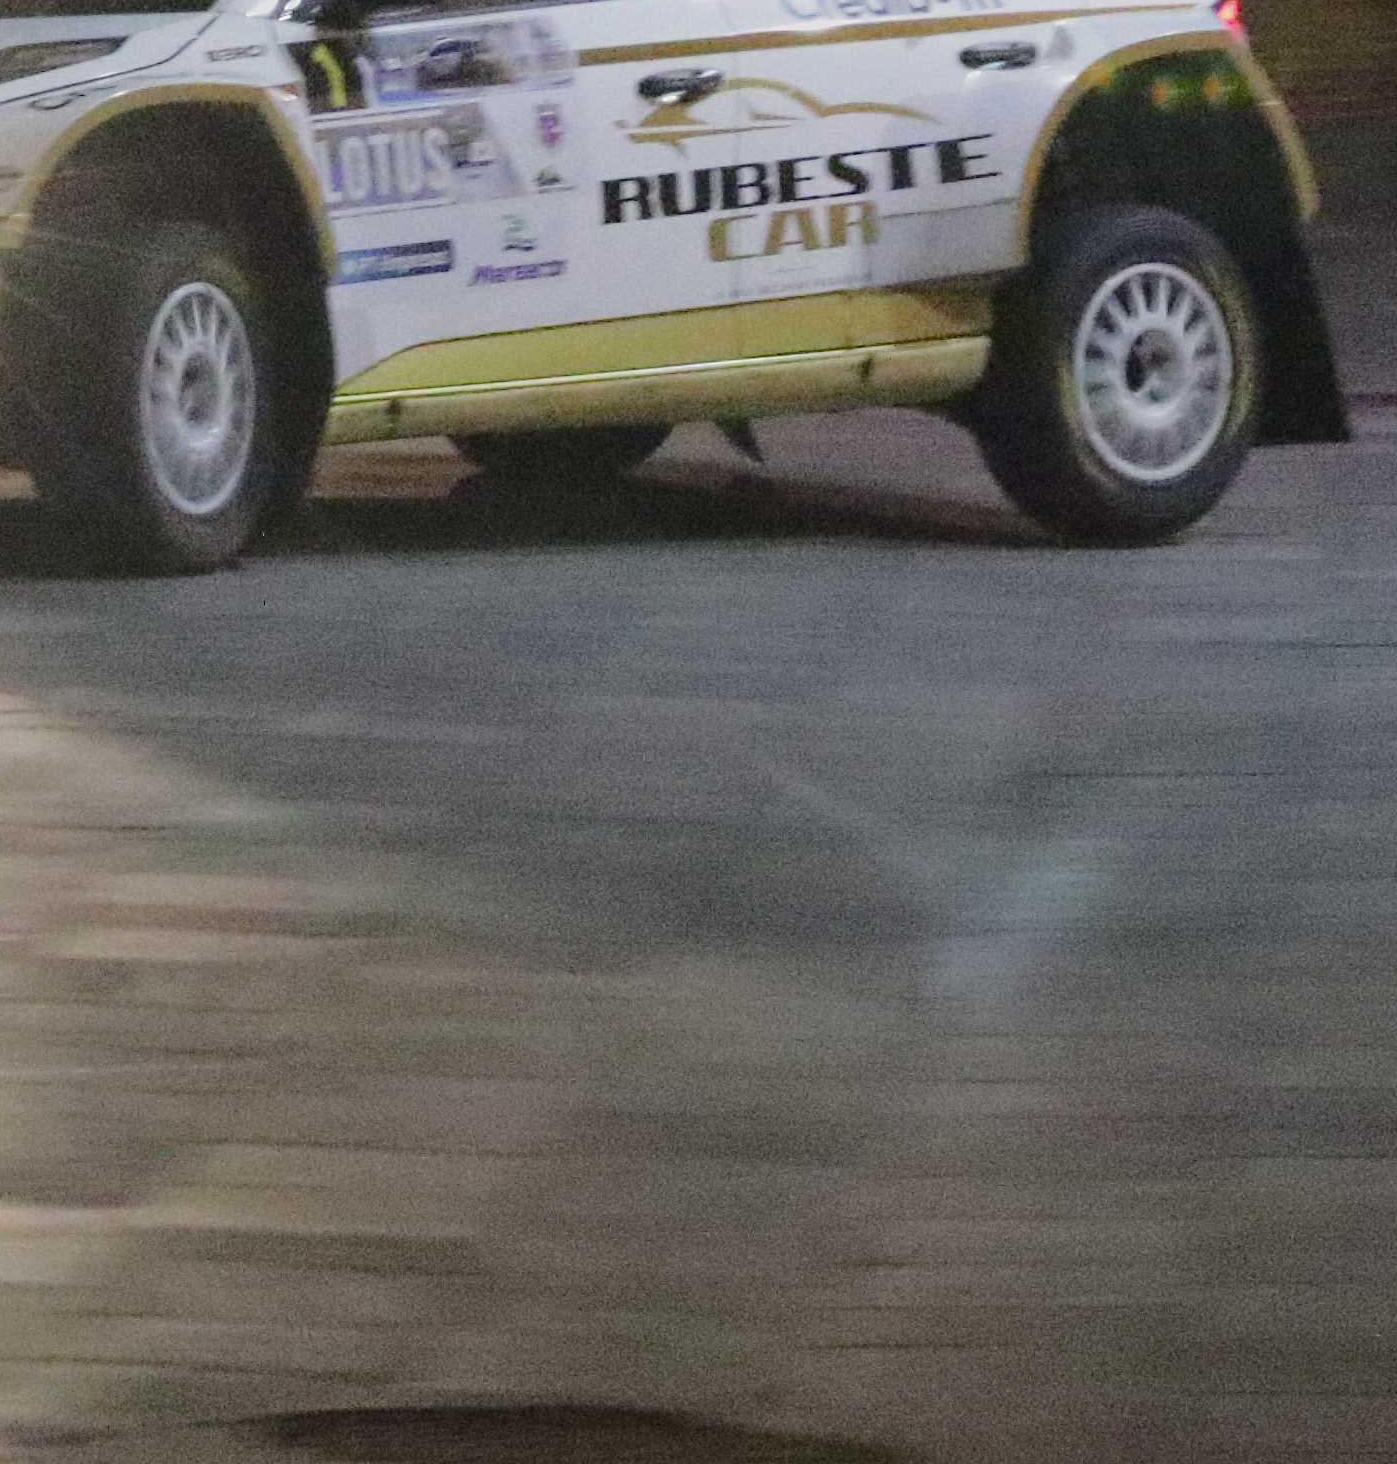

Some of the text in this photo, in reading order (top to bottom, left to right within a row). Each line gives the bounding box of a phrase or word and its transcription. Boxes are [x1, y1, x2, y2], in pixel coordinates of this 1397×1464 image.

[310, 40, 347, 107] 1
[313, 127, 453, 204] LOTUS
[601, 133, 1004, 226] RUBESTE
[707, 199, 882, 263] CAR
